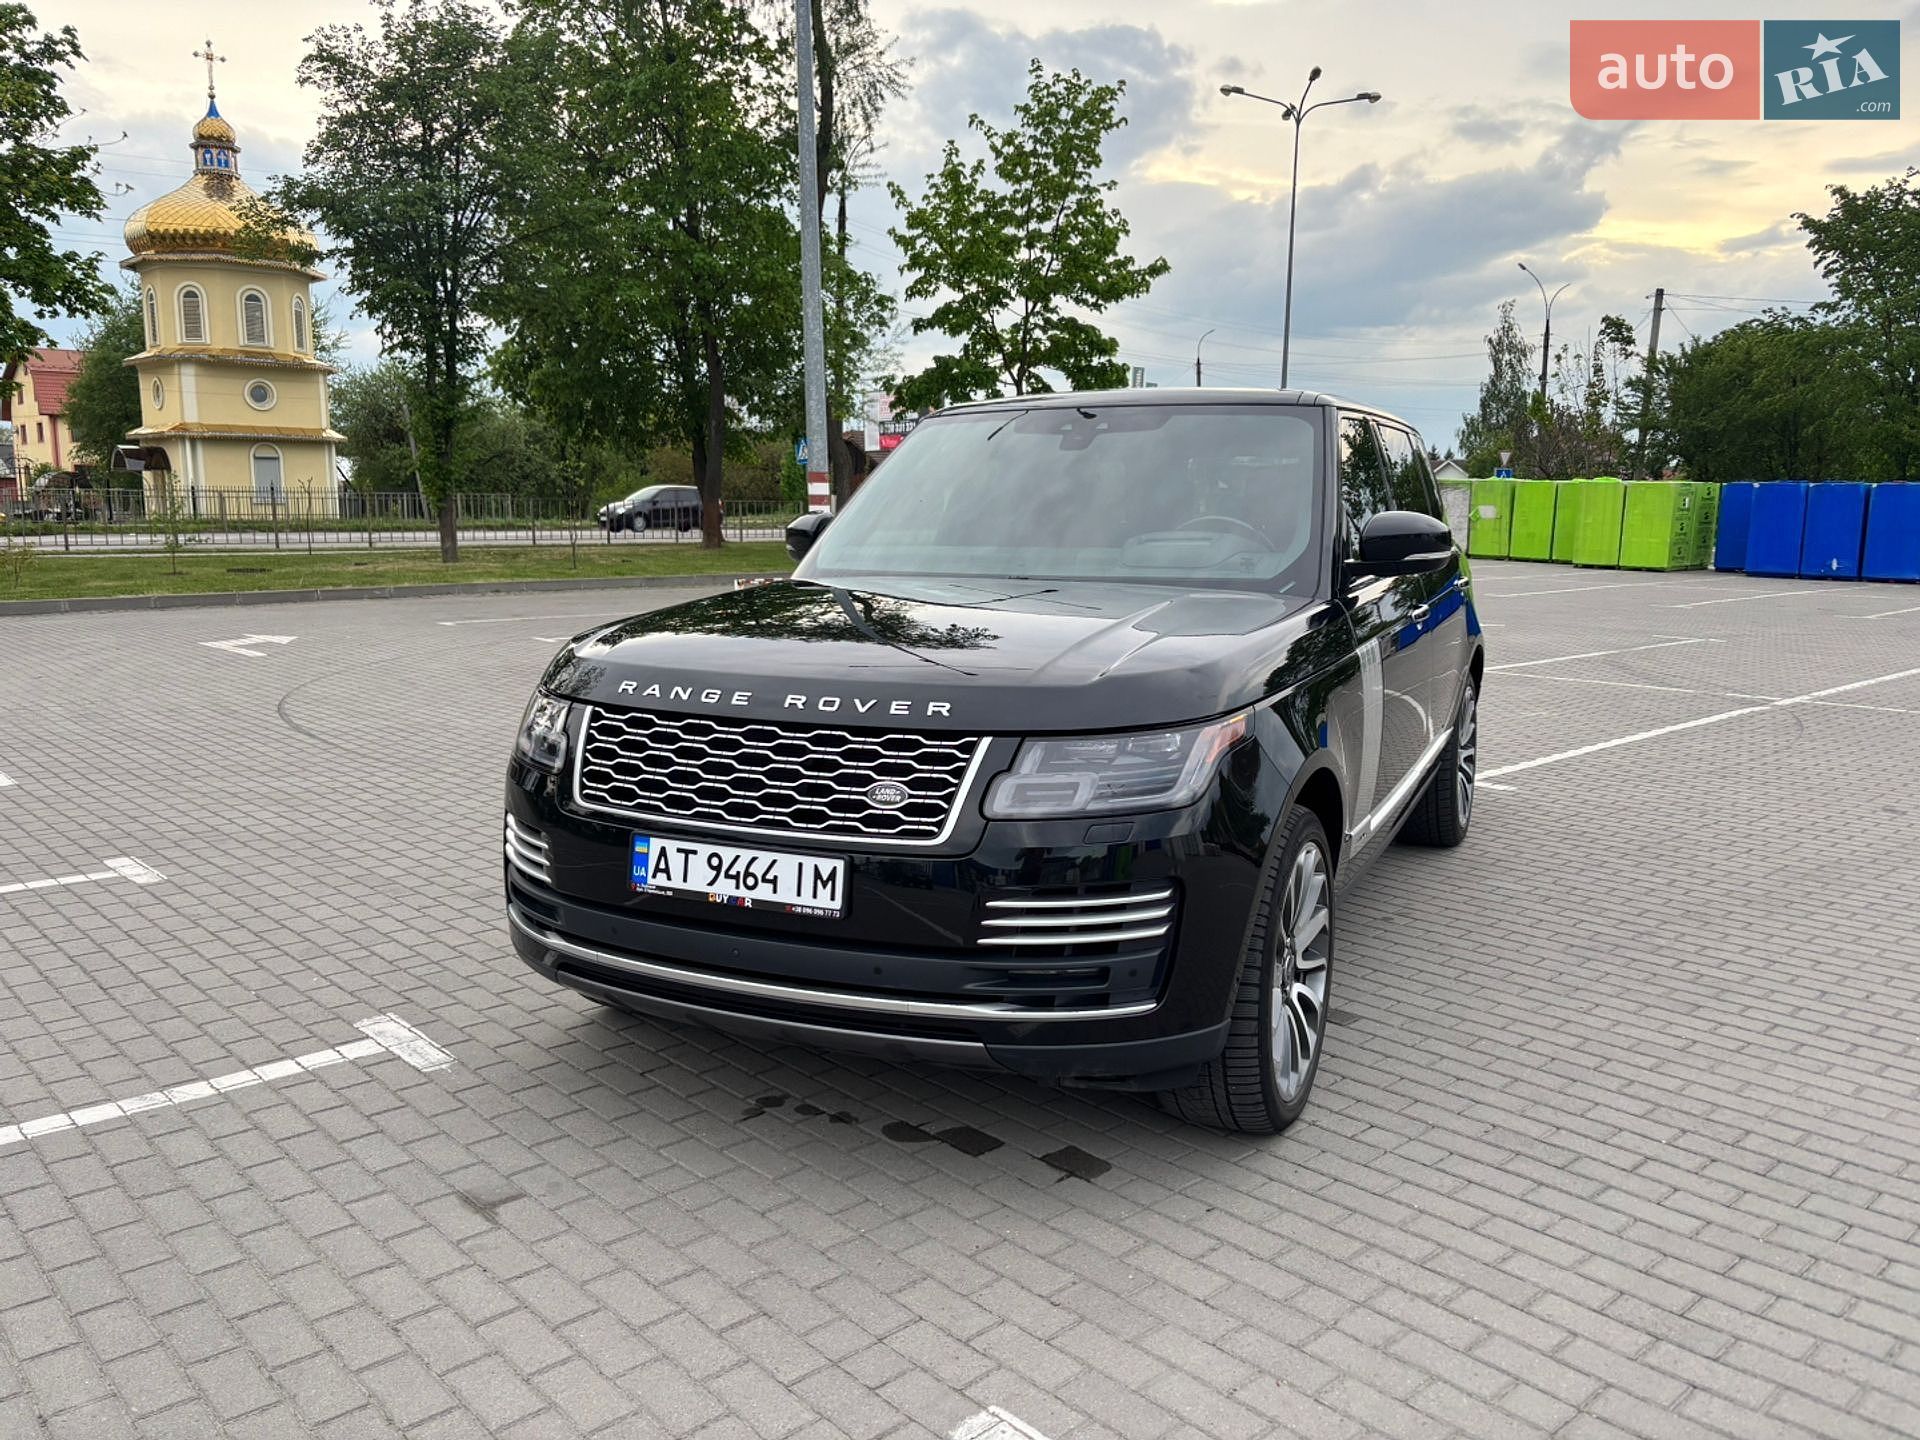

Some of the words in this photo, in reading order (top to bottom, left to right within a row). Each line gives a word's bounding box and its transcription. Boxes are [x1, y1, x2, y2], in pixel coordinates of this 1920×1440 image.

[617, 680, 752, 706] RANGE
[783, 694, 952, 718] ROVER
[633, 865, 646, 877] UA
[651, 846, 698, 883] AT
[706, 852, 778, 894] 9464
[796, 862, 838, 901] IM
